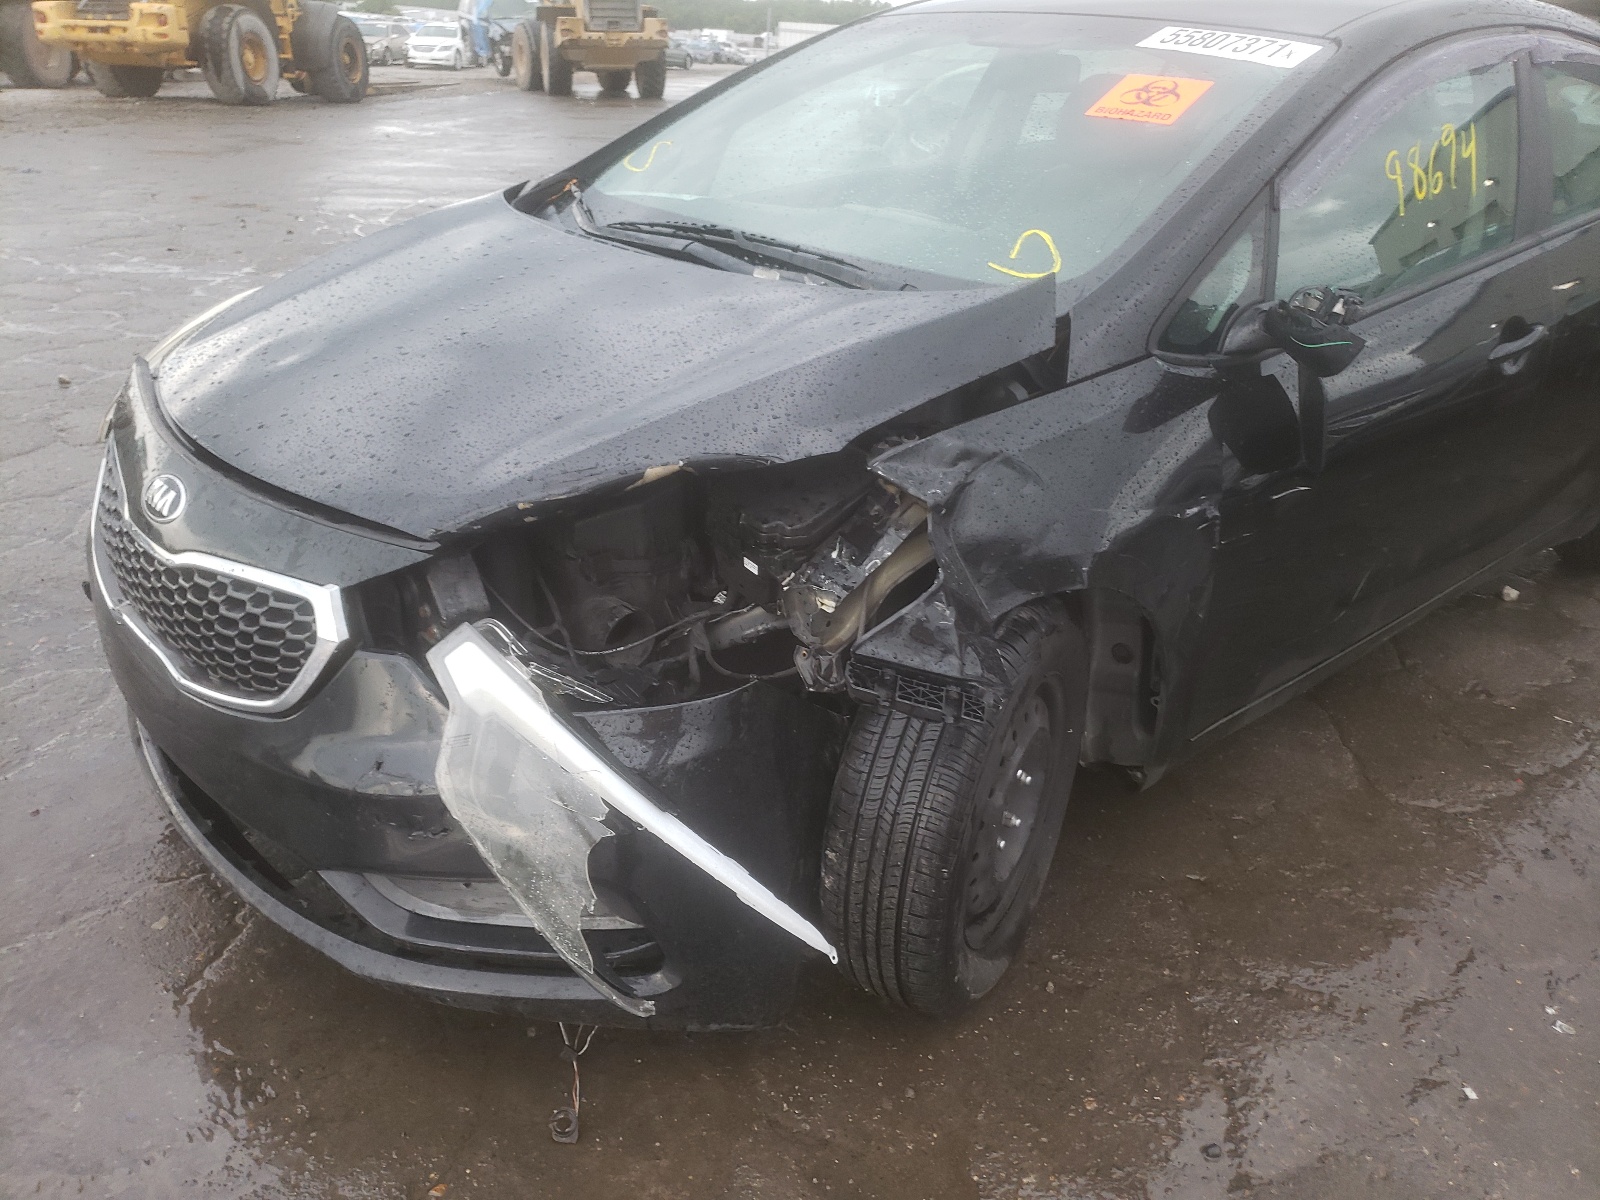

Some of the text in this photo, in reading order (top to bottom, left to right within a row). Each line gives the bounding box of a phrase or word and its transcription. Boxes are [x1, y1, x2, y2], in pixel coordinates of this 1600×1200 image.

[1160, 28, 1292, 58] 55807371
[1095, 106, 1172, 121] BIOHAZARD
[1385, 122, 1476, 216] 98694
